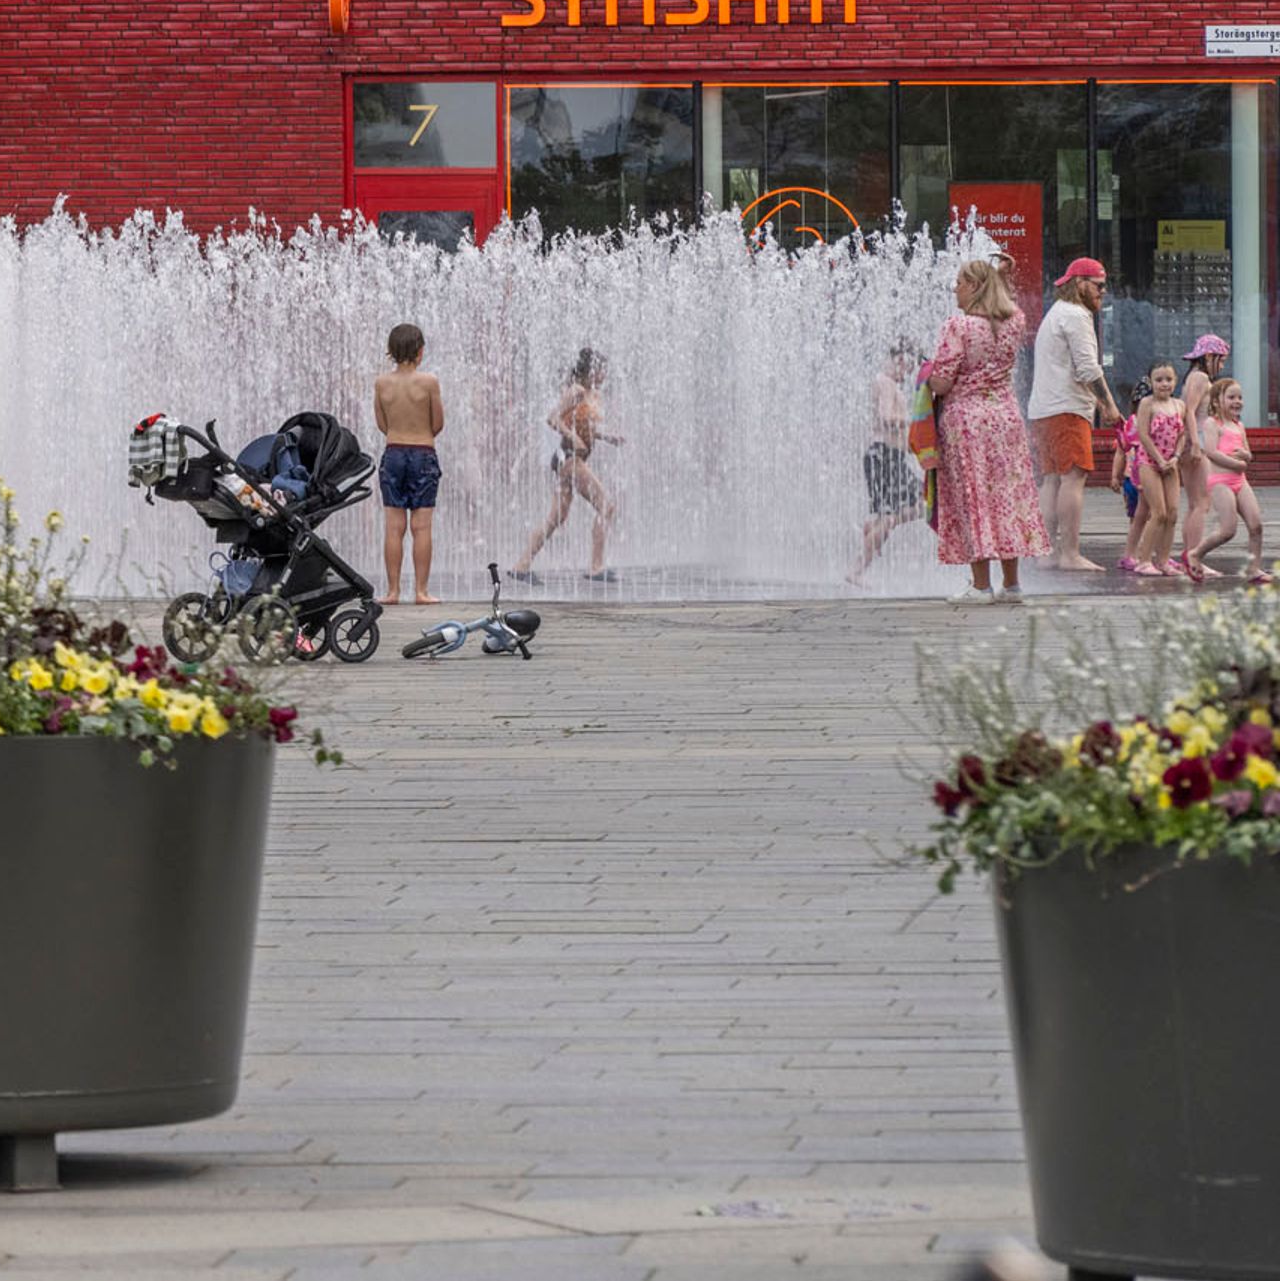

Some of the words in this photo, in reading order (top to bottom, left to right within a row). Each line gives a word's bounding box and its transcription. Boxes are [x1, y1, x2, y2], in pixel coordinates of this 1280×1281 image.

[409, 104, 439, 147] 7
[990, 213, 1008, 223] blir
[1010, 213, 1025, 223] du
